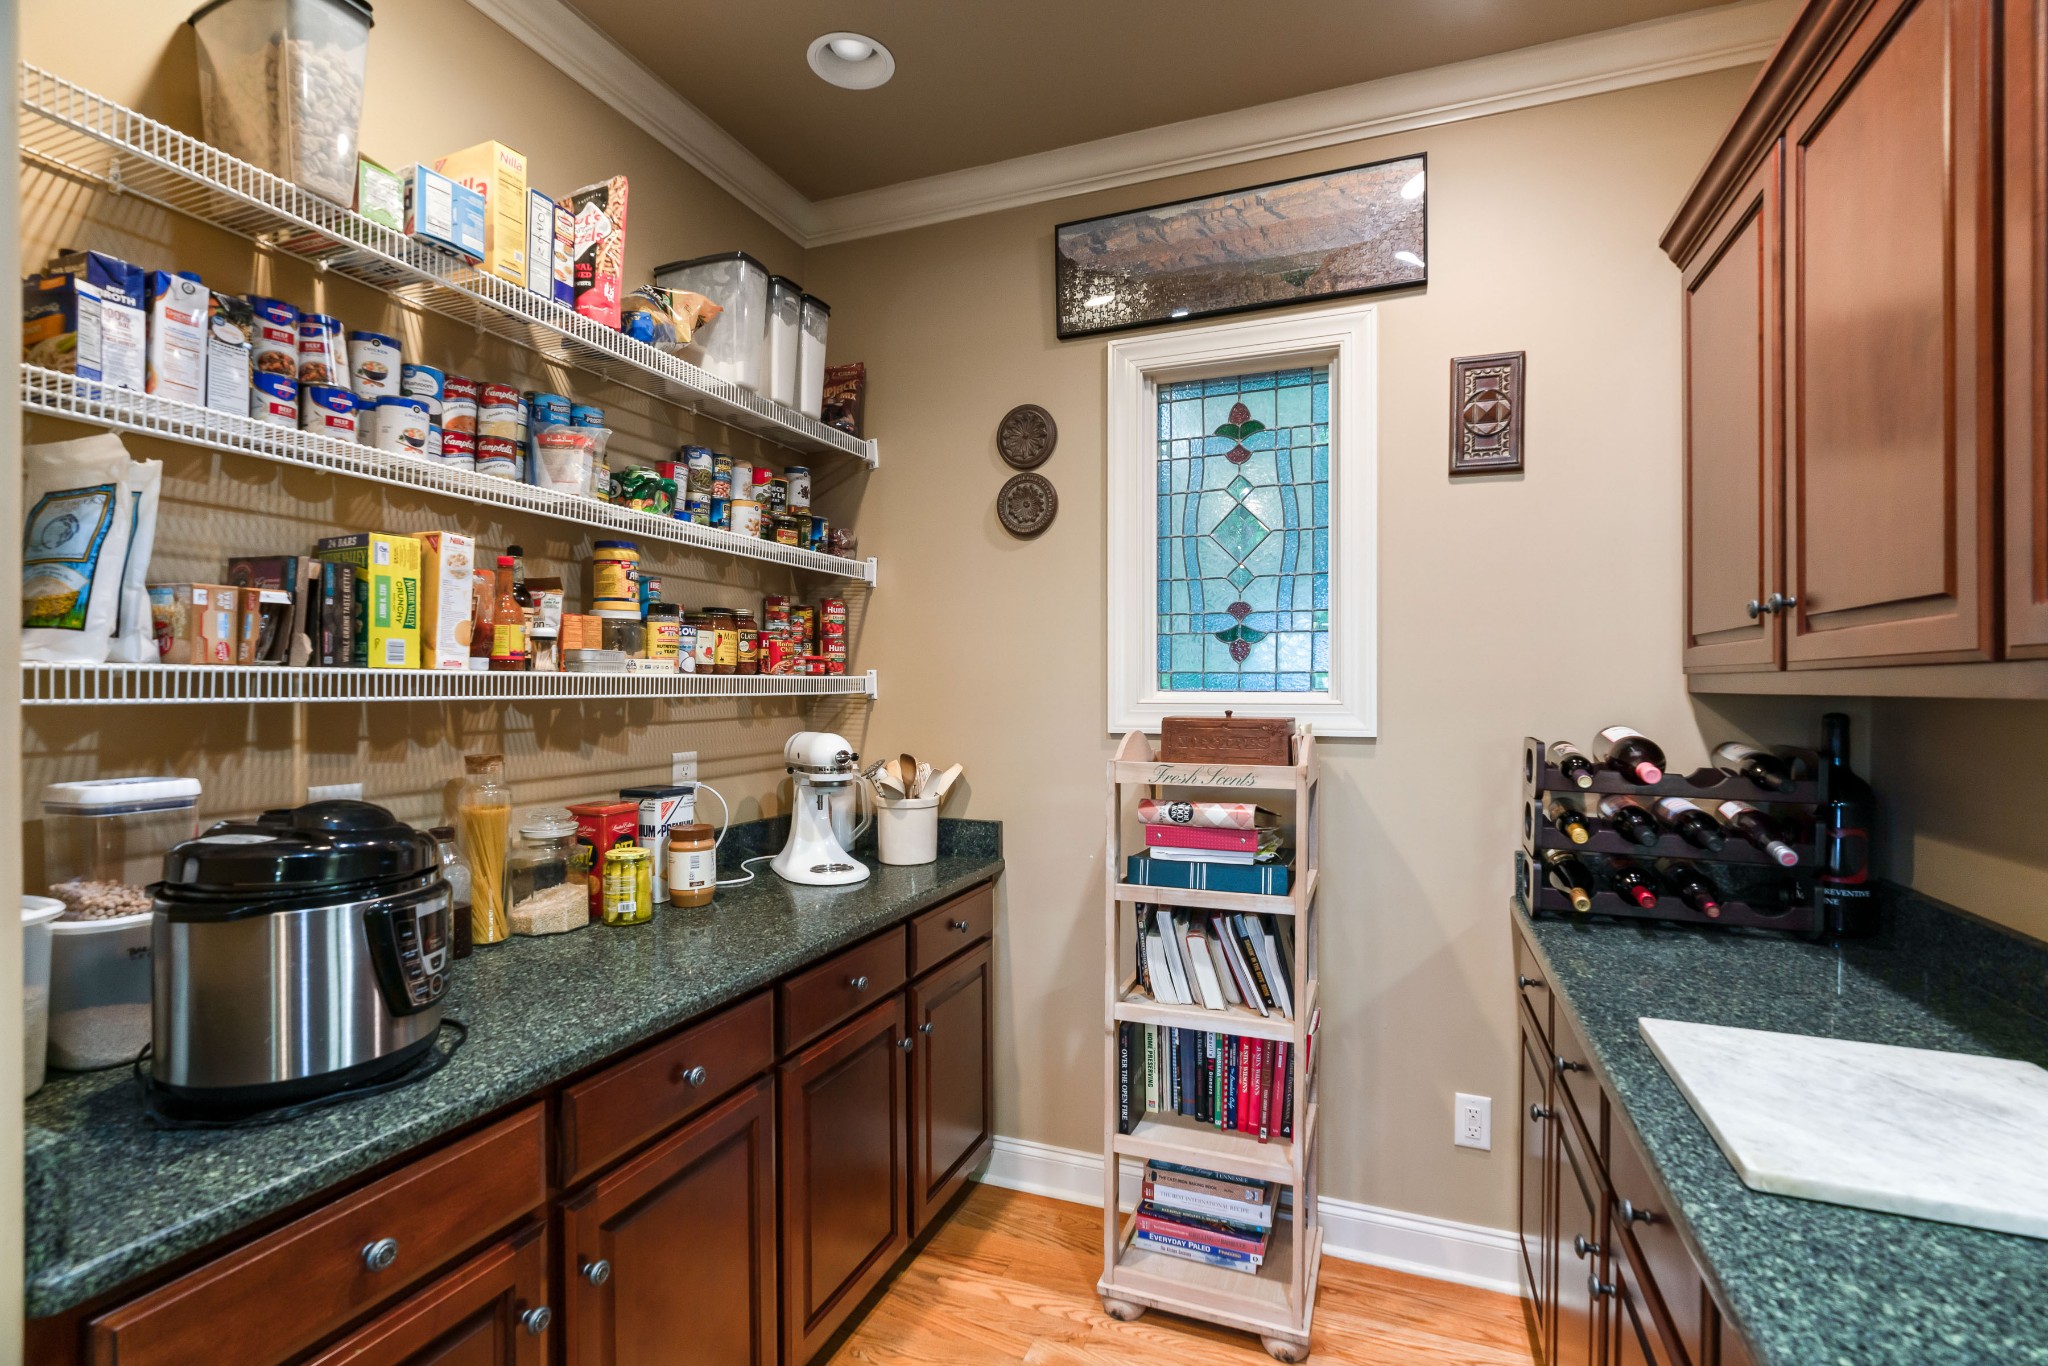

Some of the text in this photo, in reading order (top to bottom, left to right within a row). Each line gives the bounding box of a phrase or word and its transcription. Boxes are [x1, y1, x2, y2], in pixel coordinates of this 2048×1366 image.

[500, 151, 523, 172] Nilla
[272, 330, 289, 340] BEEF
[402, 380, 434, 390] Mushroom
[840, 392, 857, 401] MIX
[478, 440, 513, 455] Campbell's
[337, 536, 358, 548] BARS
[450, 537, 465, 546] Nilla
[395, 581, 404, 624] CRUNCHY
[404, 580, 416, 628] NATURE VALLEY
[342, 568, 351, 663] WHOLE GRAINS TASTE BETTER
[379, 603, 387, 619] HONEY
[1149, 764, 1257, 787] Fresh Scents
[1823, 887, 1871, 898] REVENTIVE
[1823, 897, 1841, 906] NE
[1207, 1058, 1215, 1071] TV
[1121, 1103, 1129, 1121] FIRE
[1216, 1172, 1249, 1183] TENNESSEE
[1188, 1181, 1205, 1189] BAKING
[1172, 1192, 1185, 1200] BEST
[1185, 1194, 1229, 1210] INTERNATIONAL
[1229, 1205, 1250, 1214] RECIPE
[1149, 1232, 1187, 1247] EVERYDAY
[1188, 1241, 1211, 1254] PALEO
